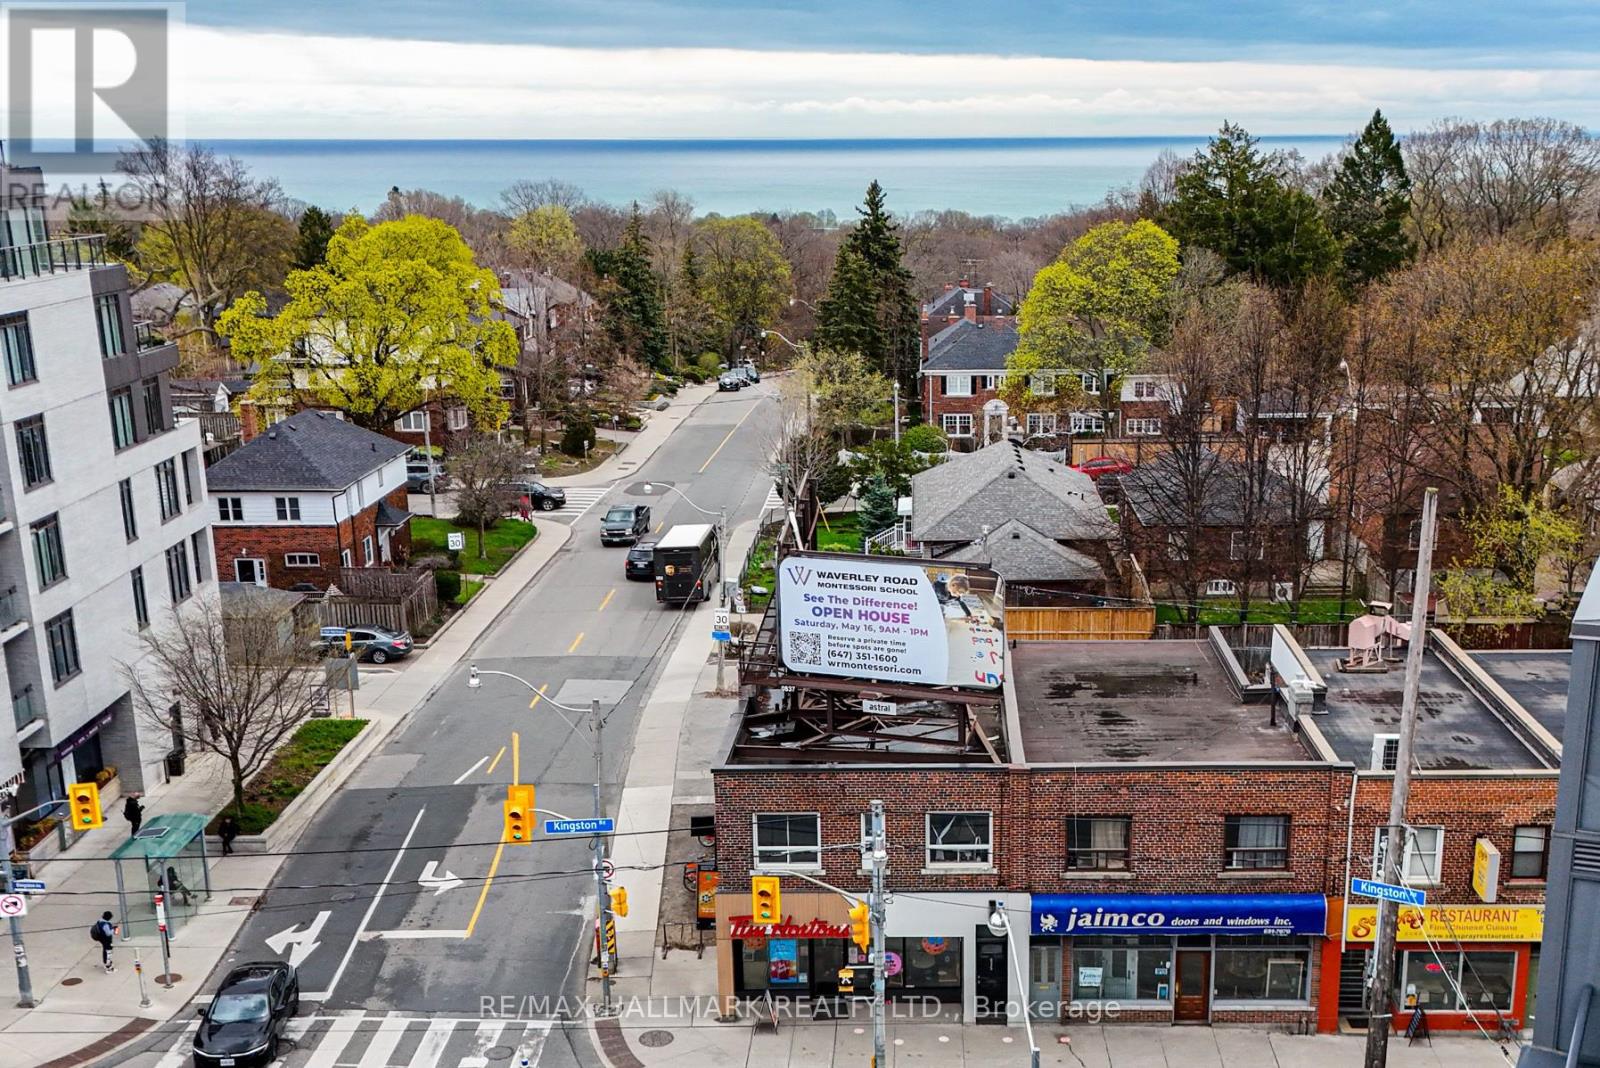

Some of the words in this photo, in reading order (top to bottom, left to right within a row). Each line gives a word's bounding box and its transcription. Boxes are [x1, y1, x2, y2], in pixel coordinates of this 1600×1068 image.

[817, 571, 879, 582] WAVERLEY
[884, 576, 918, 585] ROAD
[817, 582, 876, 591] MONTESSORI
[880, 586, 918, 595] SCHOOL
[804, 593, 824, 603] See
[828, 595, 849, 605] The
[853, 597, 918, 610] Difference!
[812, 606, 853, 619] OPEN
[858, 610, 910, 624] HOUSE
[794, 619, 838, 630] Saturday,
[841, 623, 860, 632] May
[864, 624, 876, 633] 16,
[879, 625, 900, 634] 9AM
[910, 628, 928, 636] 1PM
[828, 650, 852, 660] (647)
[856, 652, 897, 663] 351-1600
[828, 660, 921, 675] wrmontessori.com
[869, 703, 890, 711] astral
[553, 820, 597, 832] Kingston
[1361, 882, 1406, 899] Kingston
[1066, 908, 1165, 931] jaimco
[1171, 916, 1199, 926] doors
[1203, 916, 1223, 925] and
[1227, 916, 1270, 925] windows
[1274, 916, 1291, 925] inc.
[1430, 909, 1520, 922] RESTAURANT
